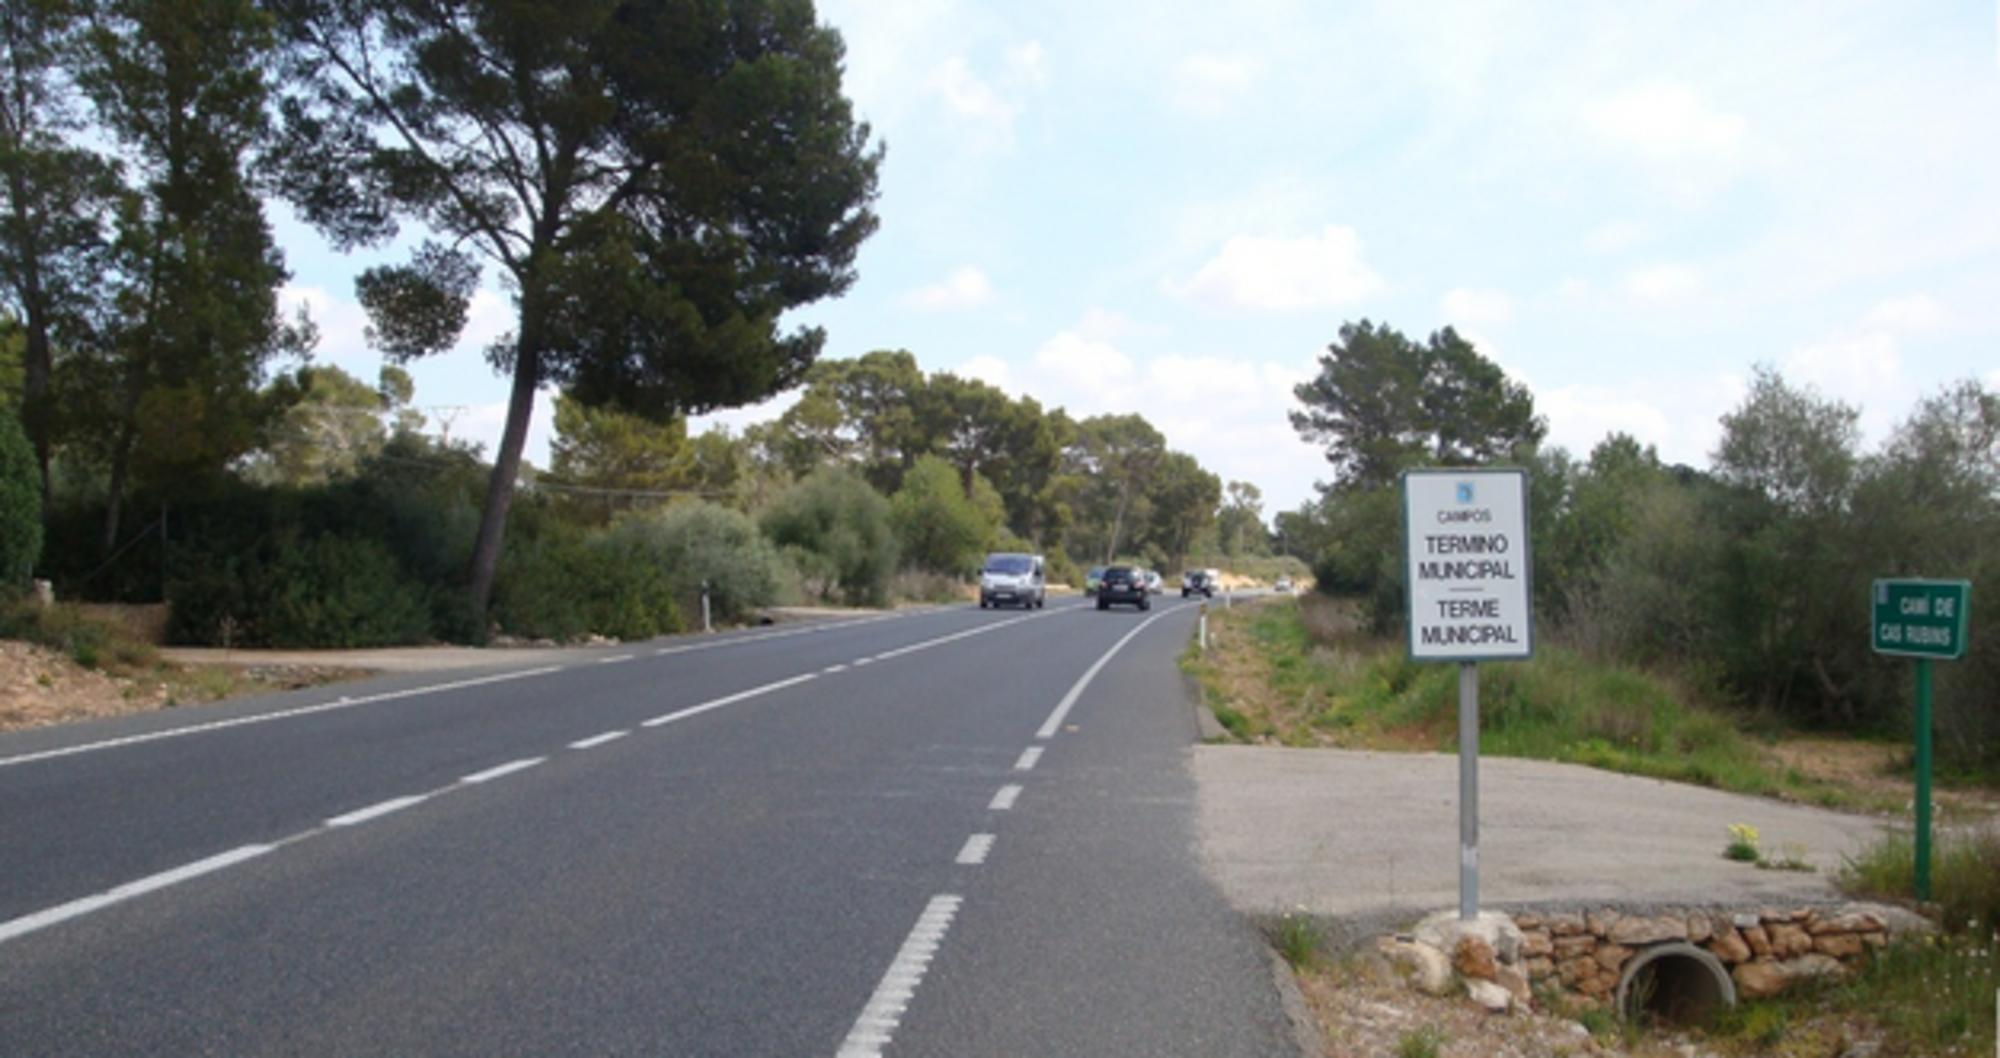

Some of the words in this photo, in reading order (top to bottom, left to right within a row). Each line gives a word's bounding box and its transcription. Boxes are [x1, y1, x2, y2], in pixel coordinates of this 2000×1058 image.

[1437, 508, 1492, 524] CAMPOS
[1425, 534, 1508, 554] TERMINO
[1418, 560, 1515, 581] MUNICIPAL
[1436, 599, 1500, 618] TERME
[1934, 597, 1955, 617] DE
[1421, 625, 1518, 646] MUNICIPAL
